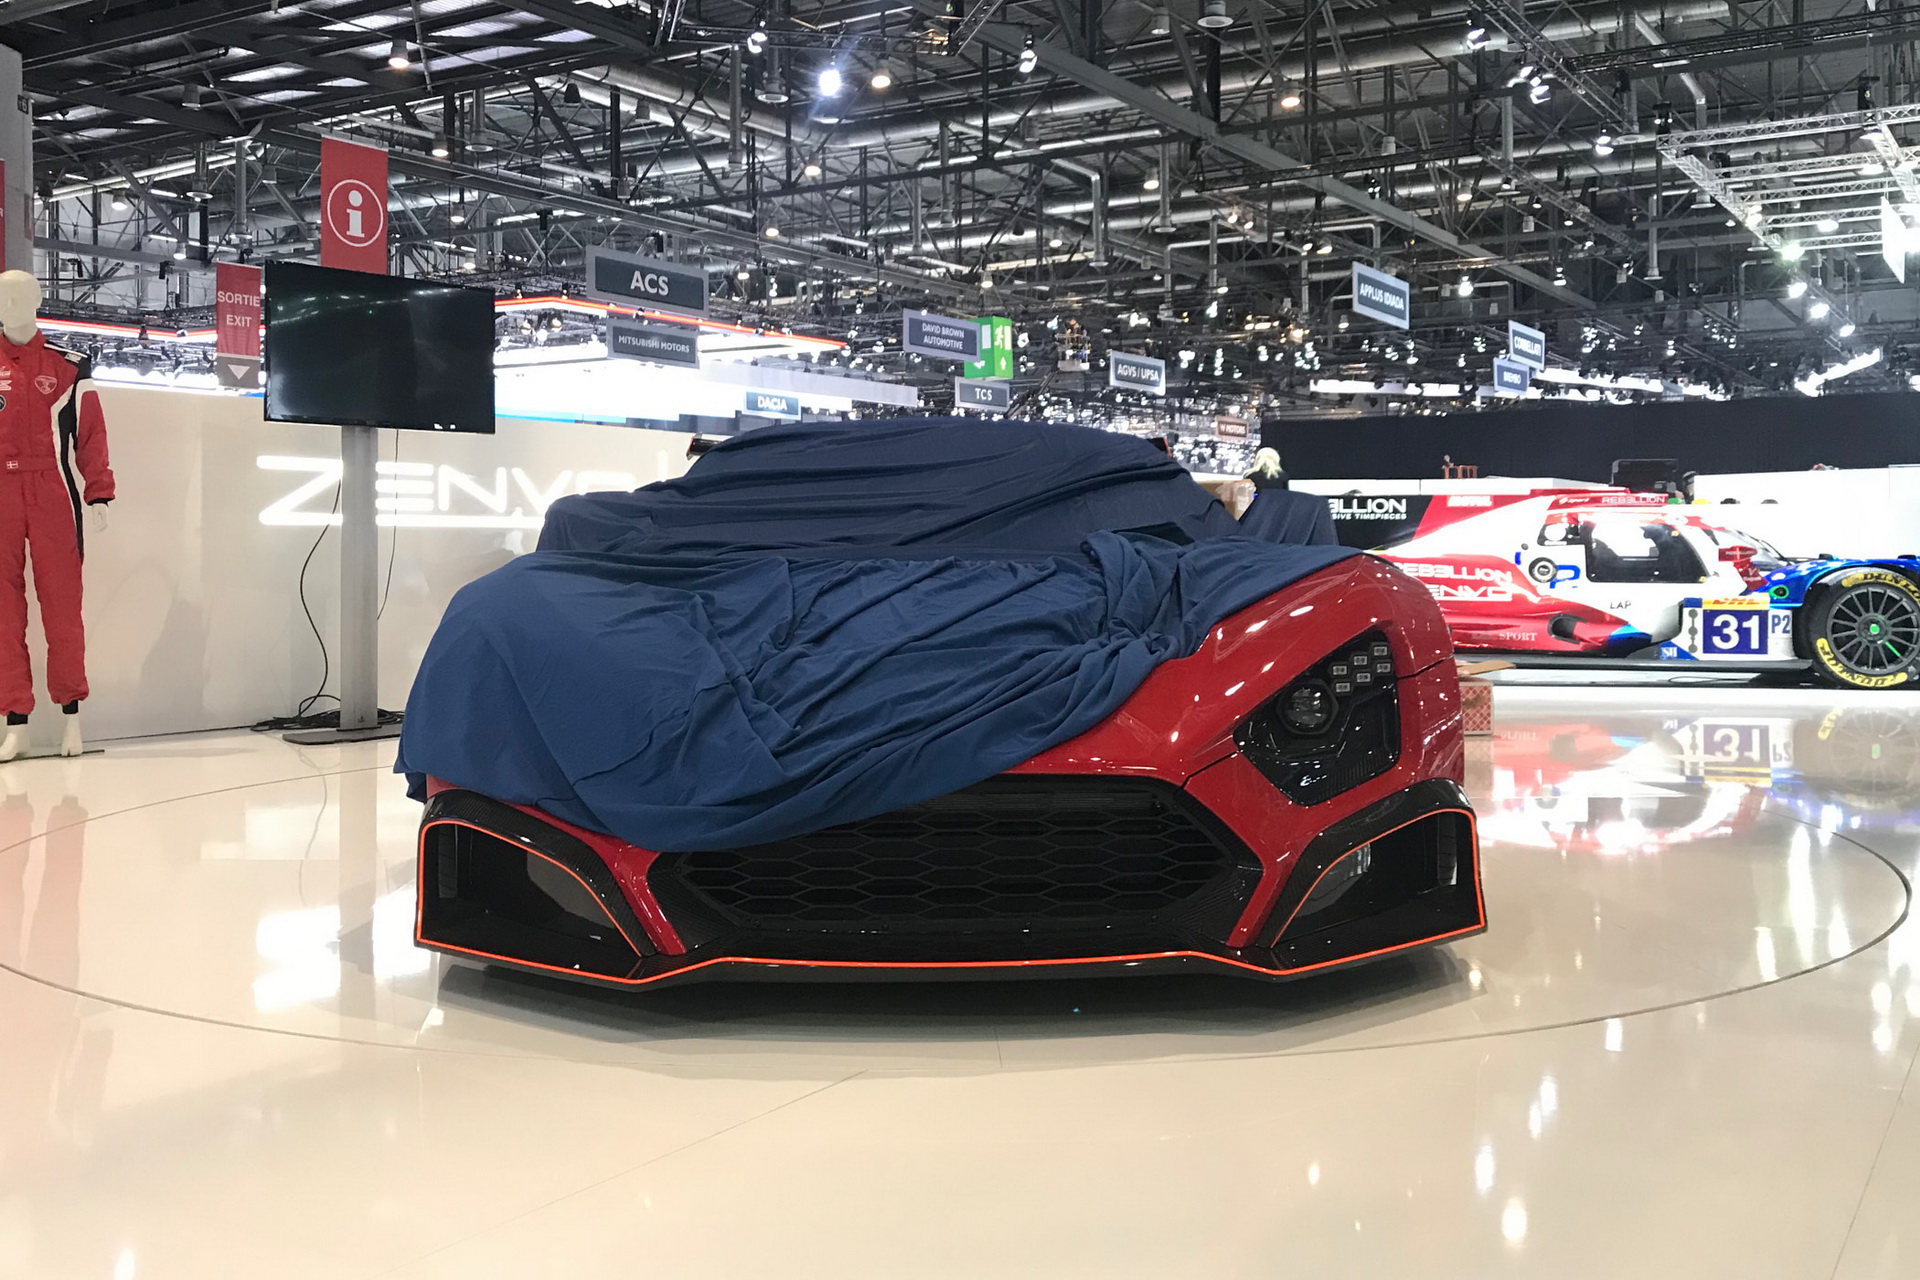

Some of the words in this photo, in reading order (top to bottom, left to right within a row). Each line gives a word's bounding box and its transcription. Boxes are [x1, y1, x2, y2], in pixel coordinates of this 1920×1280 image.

[630, 270, 669, 296] ACS
[217, 290, 260, 307] SORTIE
[1360, 283, 1384, 303] APPLUS
[226, 314, 252, 328] EXIT
[922, 322, 940, 335] DAVID
[941, 327, 965, 339] BROWN
[618, 335, 660, 348] MITSUBISHI
[660, 342, 690, 354] MOTORS
[923, 334, 963, 350] AUTOMOTIVE
[1117, 363, 1137, 378] AGVS
[1141, 368, 1160, 382] UPSA
[975, 388, 993, 401] TCS
[757, 396, 788, 411] DACIA
[1602, 496, 1665, 504] REBELLION
[1712, 613, 1760, 650] 31
[1771, 614, 1791, 635] P2
[1499, 632, 1538, 642] SPORT
